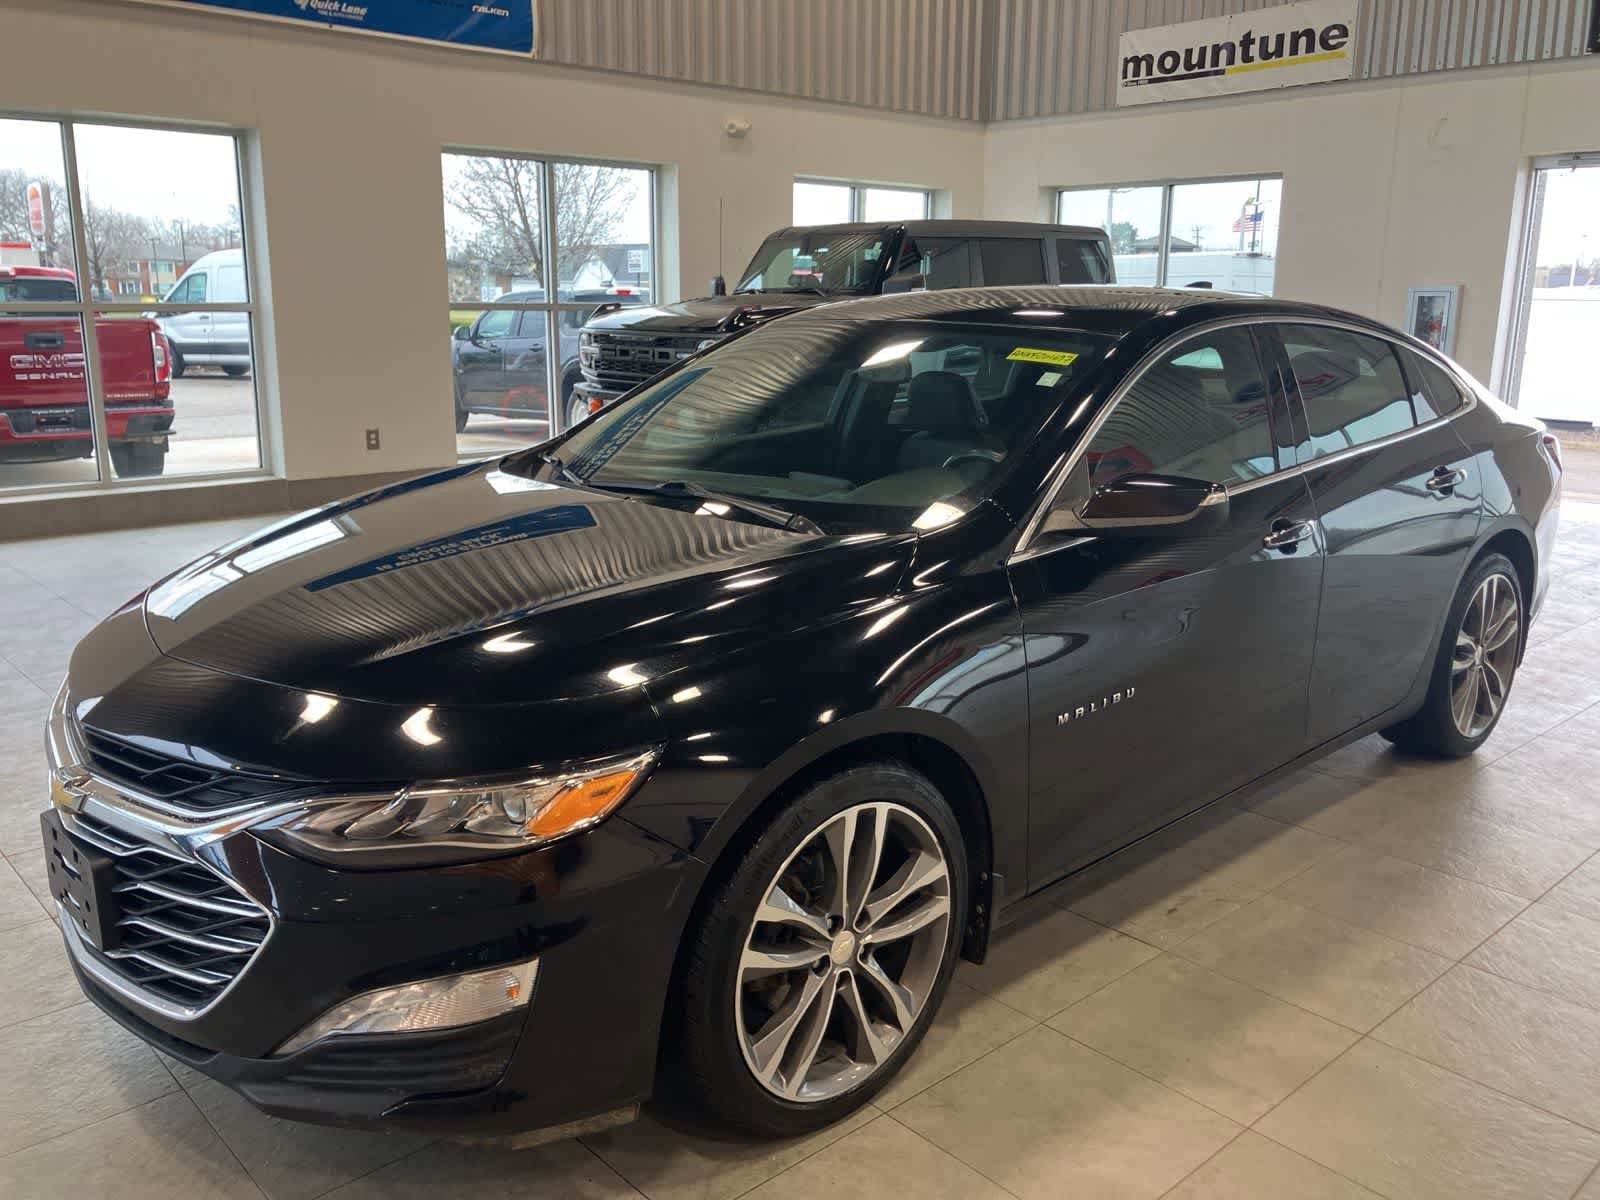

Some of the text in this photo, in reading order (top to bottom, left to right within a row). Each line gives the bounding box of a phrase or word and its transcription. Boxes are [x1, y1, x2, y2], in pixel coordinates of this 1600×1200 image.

[310, 0, 341, 11] Quick
[341, 3, 368, 16] Lane
[1122, 23, 1349, 79] mountune
[10, 353, 84, 369] GMC
[15, 372, 83, 380] DENALI
[1057, 687, 1135, 726] MALIBU
